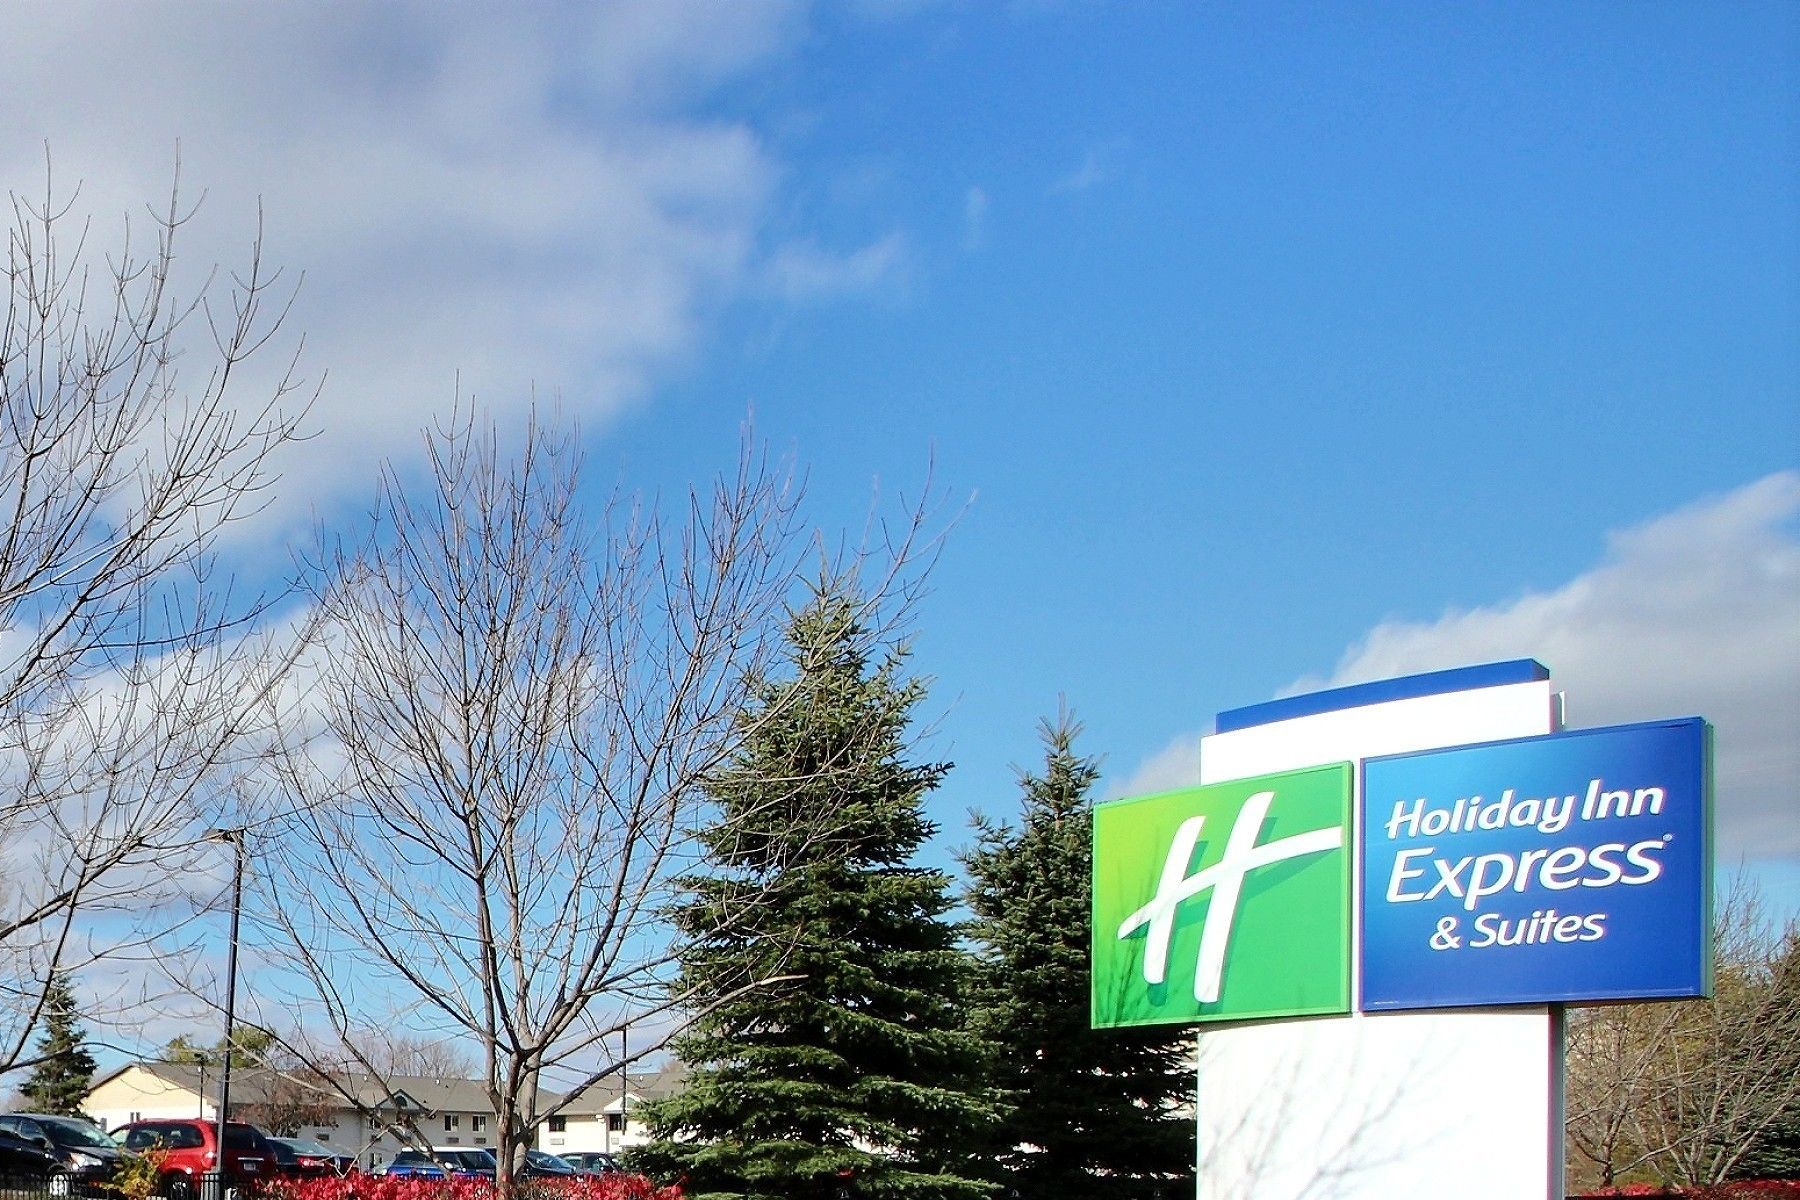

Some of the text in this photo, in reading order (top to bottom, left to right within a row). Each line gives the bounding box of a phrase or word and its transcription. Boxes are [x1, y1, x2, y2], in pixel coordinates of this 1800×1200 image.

[1384, 778, 1664, 839] Holiday Inn
[1429, 909, 1606, 951] & Suites
